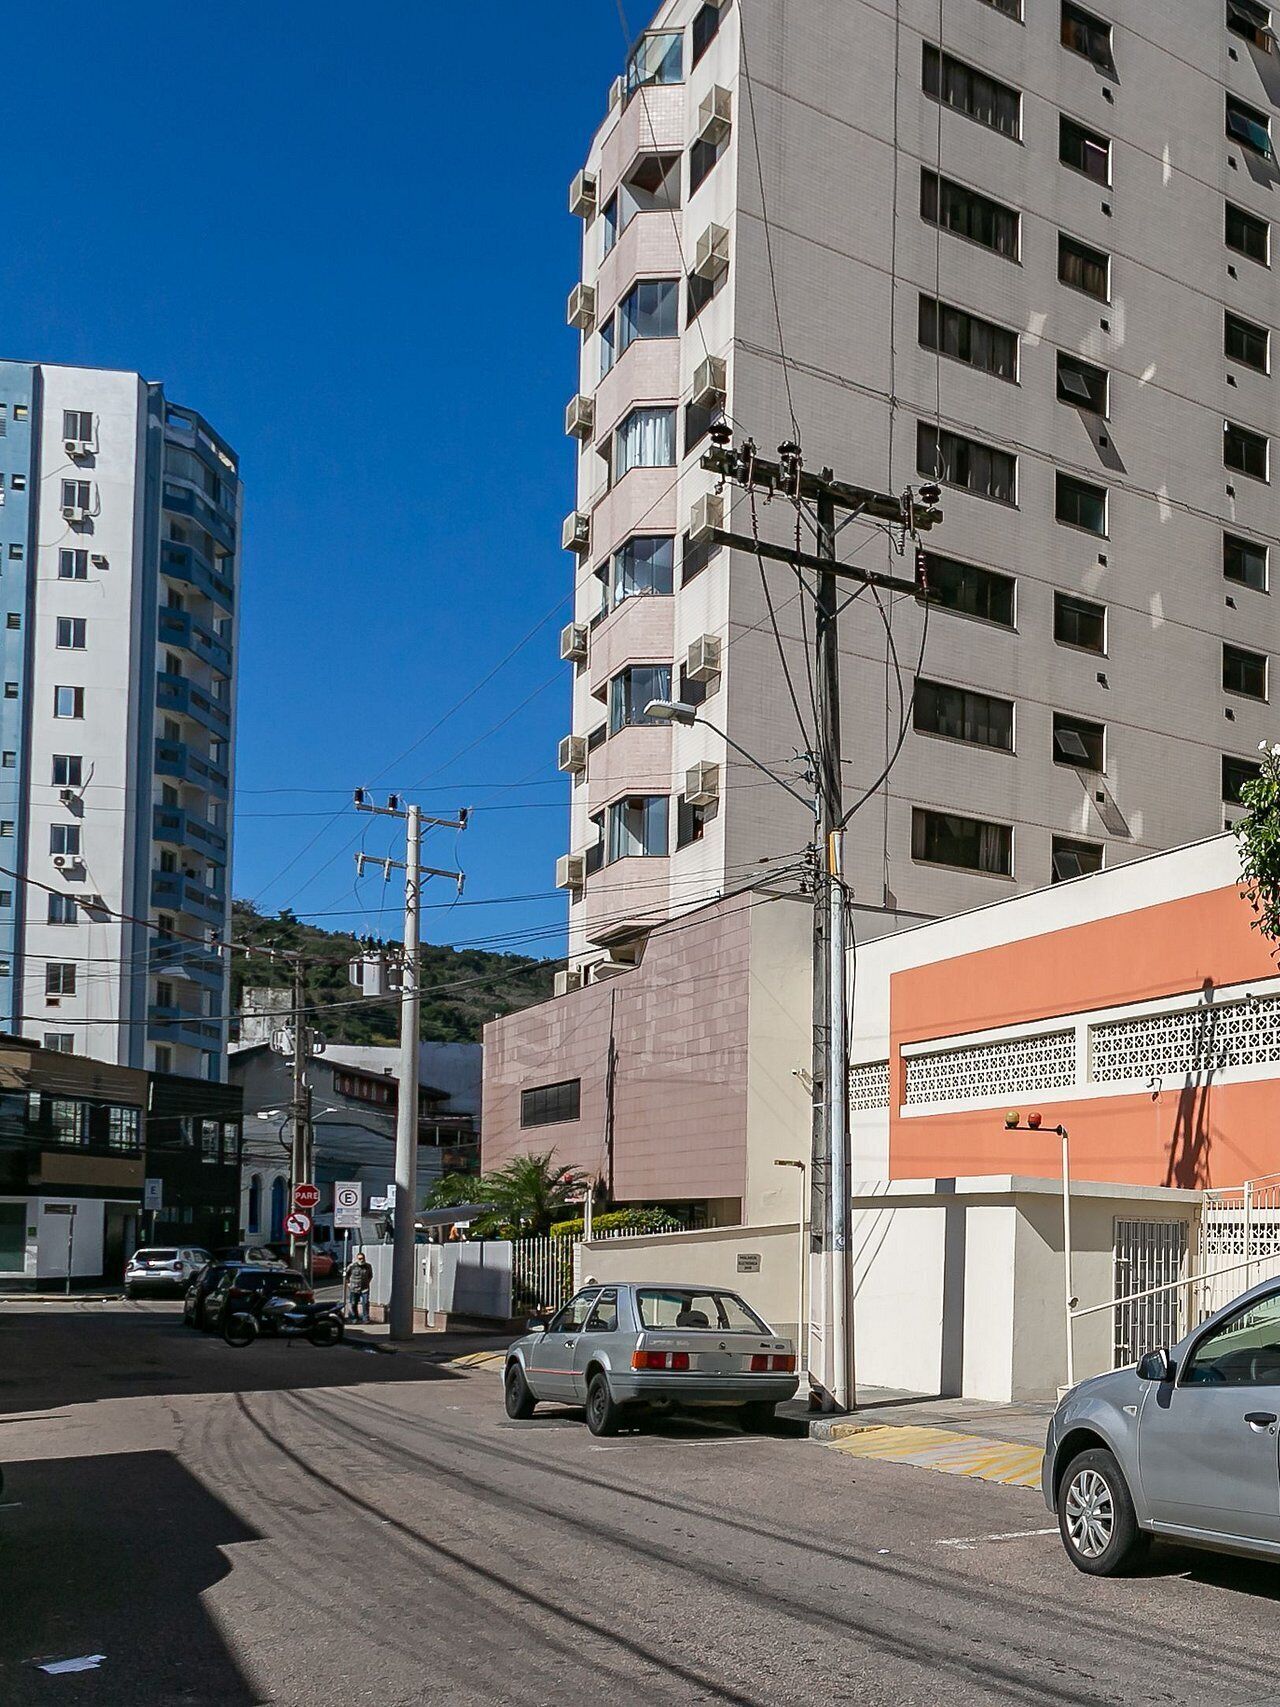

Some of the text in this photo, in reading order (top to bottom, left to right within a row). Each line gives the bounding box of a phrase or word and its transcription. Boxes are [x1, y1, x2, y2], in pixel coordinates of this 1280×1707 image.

[150, 1186, 158, 1195] E
[294, 1192, 319, 1200] PARE
[344, 1192, 352, 1204] E
